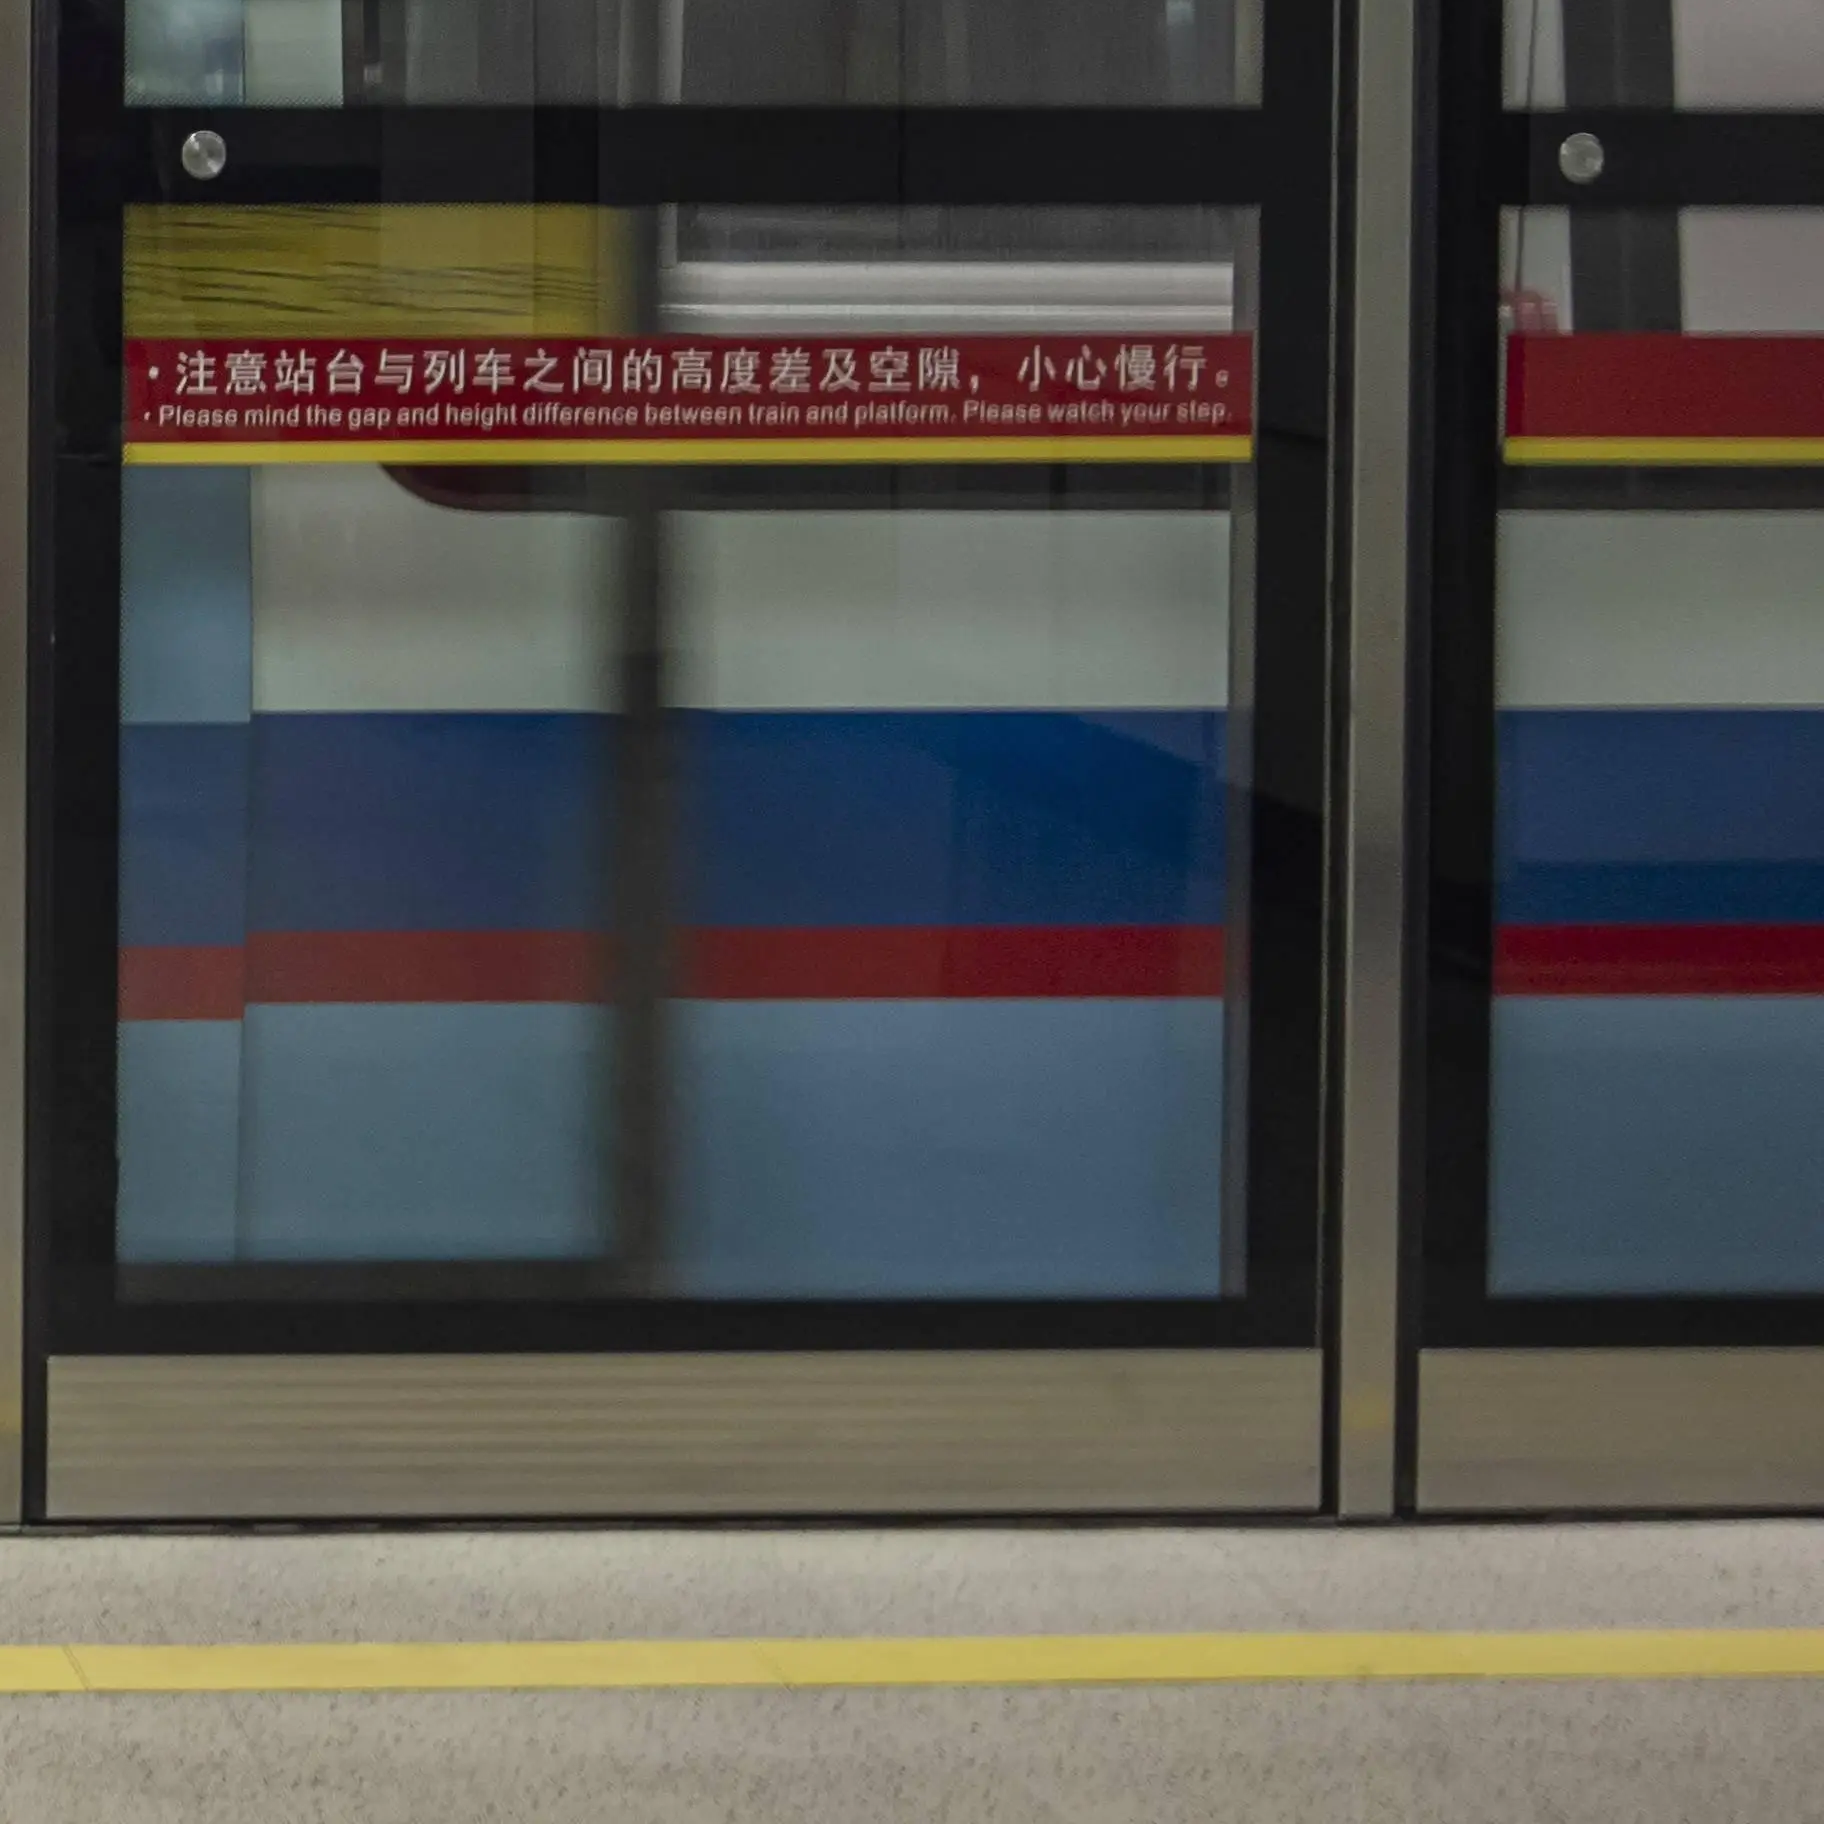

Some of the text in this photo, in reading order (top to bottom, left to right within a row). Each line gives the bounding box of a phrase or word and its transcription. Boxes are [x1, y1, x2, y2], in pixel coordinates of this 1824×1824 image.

[159, 404, 238, 426] Please
[245, 404, 300, 426] mind
[306, 404, 342, 425] the
[348, 407, 391, 431] gap
[397, 404, 439, 426] and
[445, 402, 517, 431] height
[522, 402, 639, 425] difference
[645, 402, 742, 426] between
[748, 402, 800, 425] train
[806, 401, 848, 425] and
[963, 399, 1042, 423] Please
[1048, 399, 1115, 423] watch
[1120, 401, 1169, 427] your
